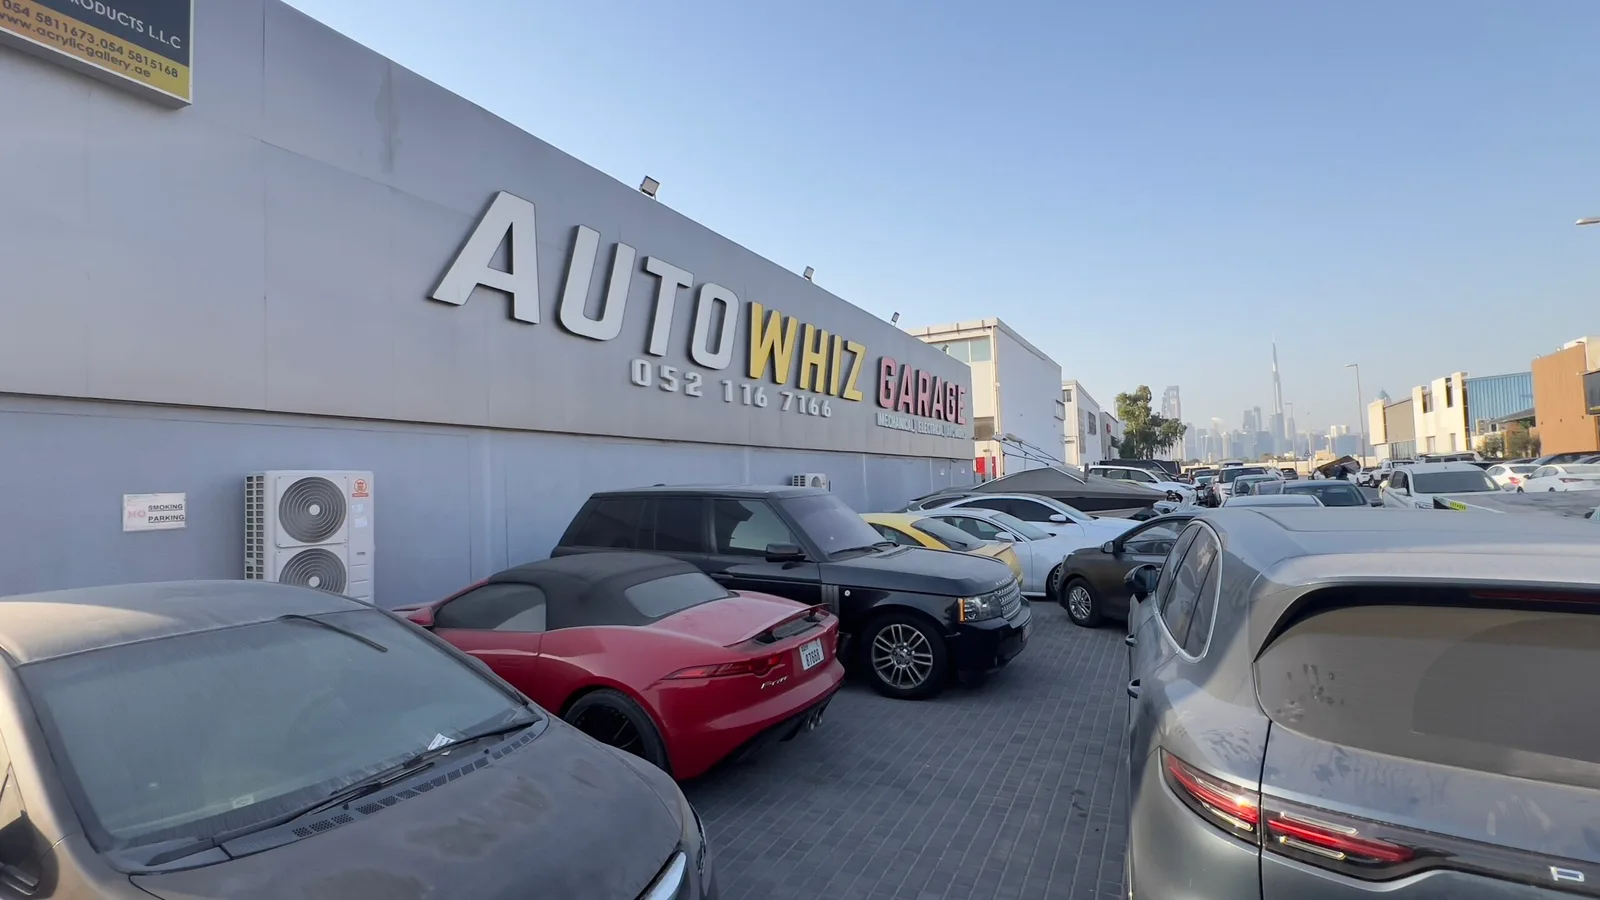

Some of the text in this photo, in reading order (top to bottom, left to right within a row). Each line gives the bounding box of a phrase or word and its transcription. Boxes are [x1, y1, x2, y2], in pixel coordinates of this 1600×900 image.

[3, 0, 30, 17] 054
[127, 50, 179, 78] 5815168
[148, 25, 181, 49] L.L.C
[631, 358, 832, 418] 052 116 7166
[877, 356, 967, 425] GARAGE
[127, 510, 146, 519] NO
[148, 514, 185, 523] PARKING
